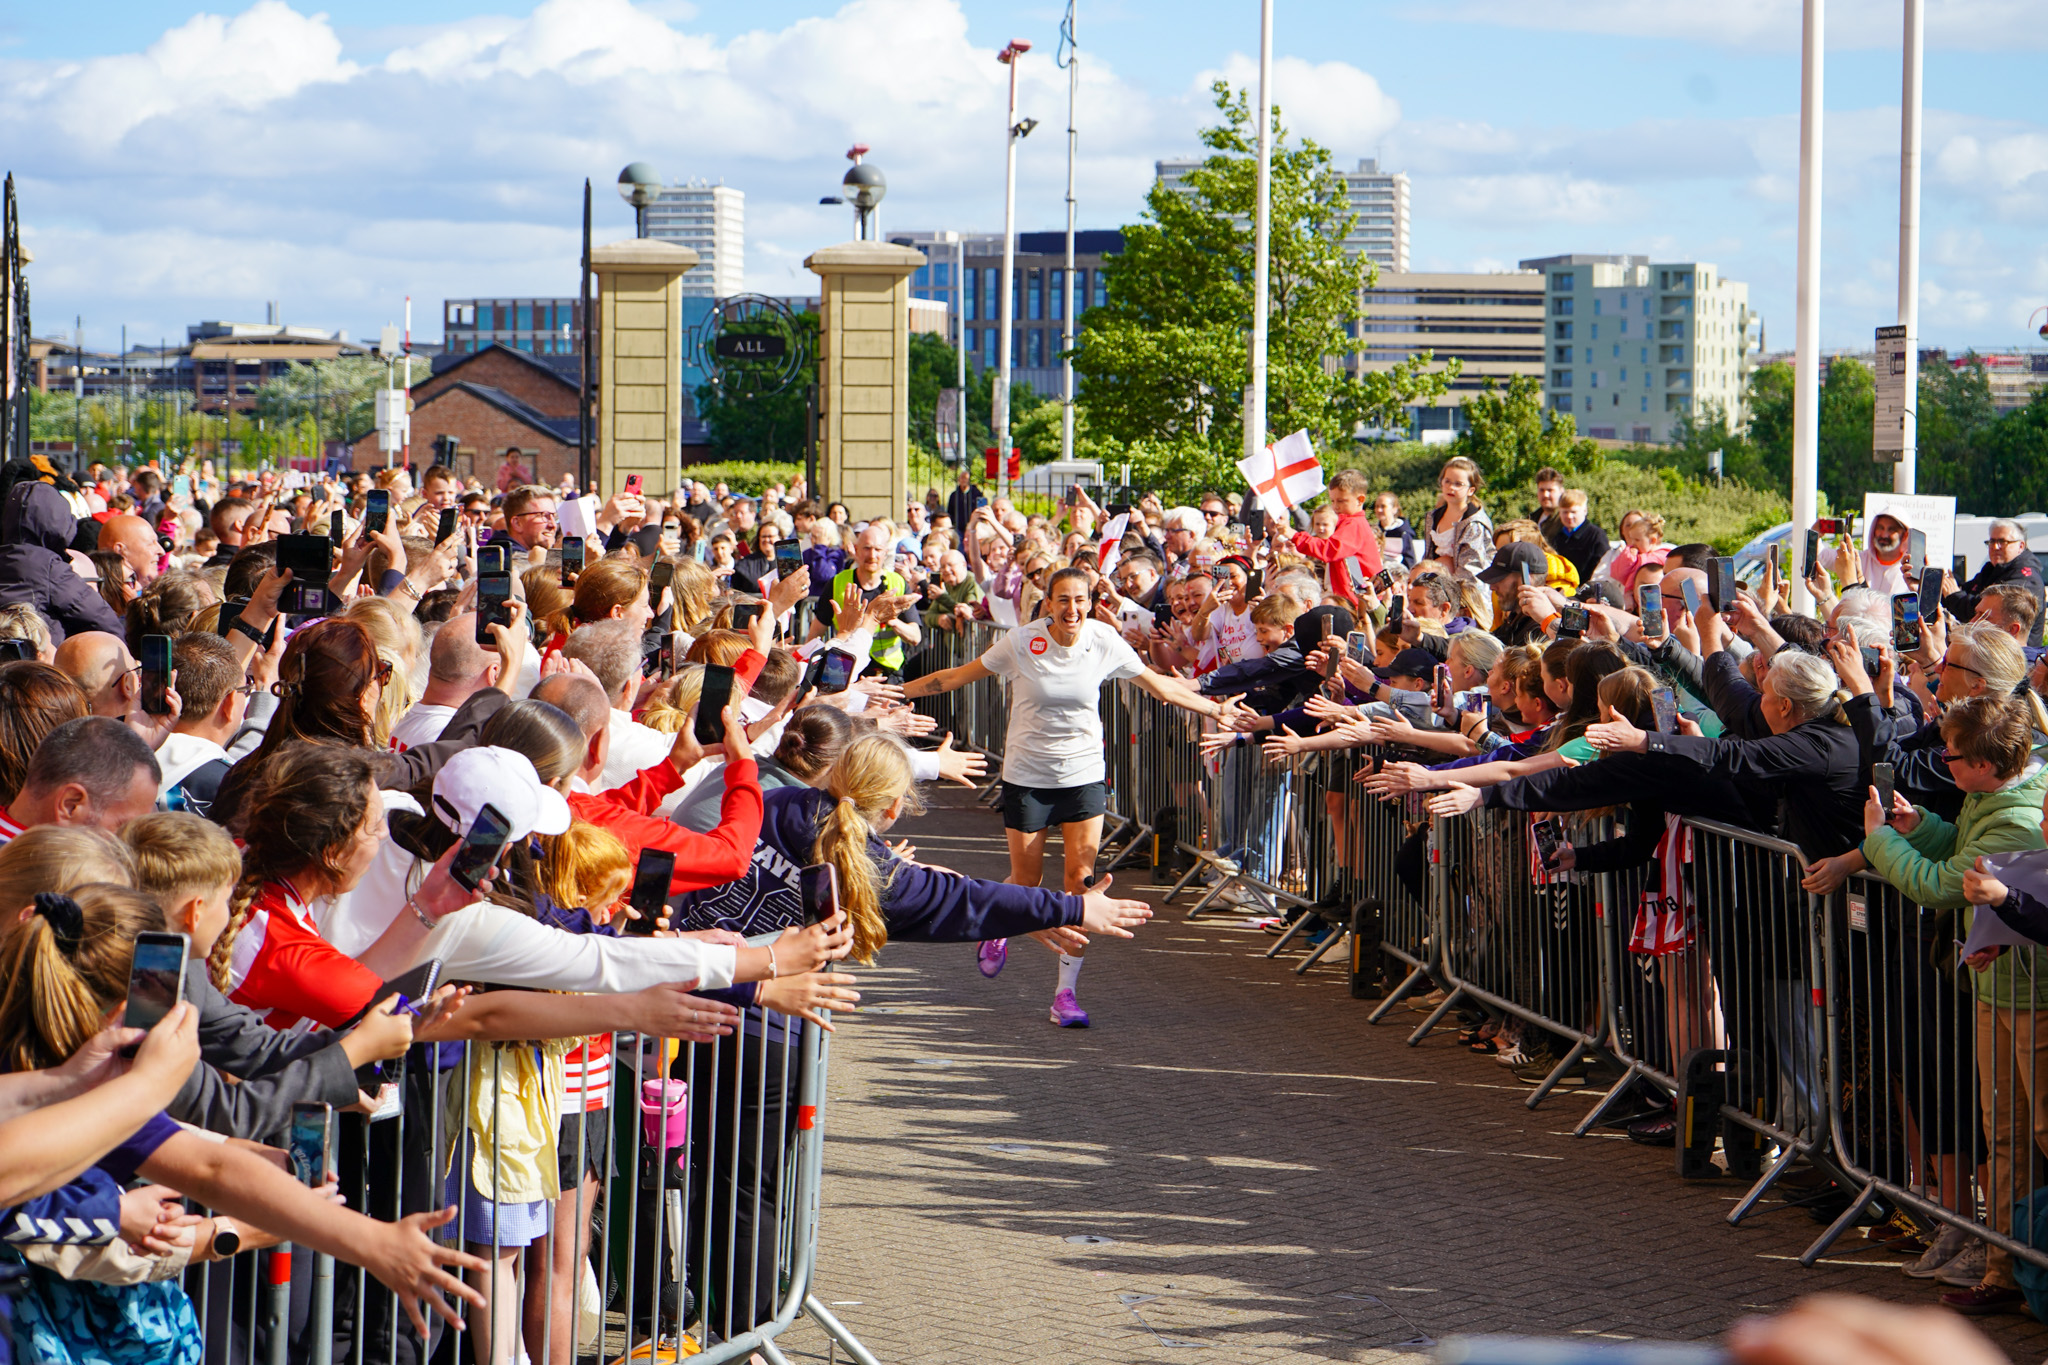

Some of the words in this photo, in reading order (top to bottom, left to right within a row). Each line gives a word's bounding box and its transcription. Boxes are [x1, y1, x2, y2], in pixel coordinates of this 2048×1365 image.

[733, 340, 766, 353] ALL
[1923, 511, 1947, 522] Light
[751, 837, 802, 892] AVE
